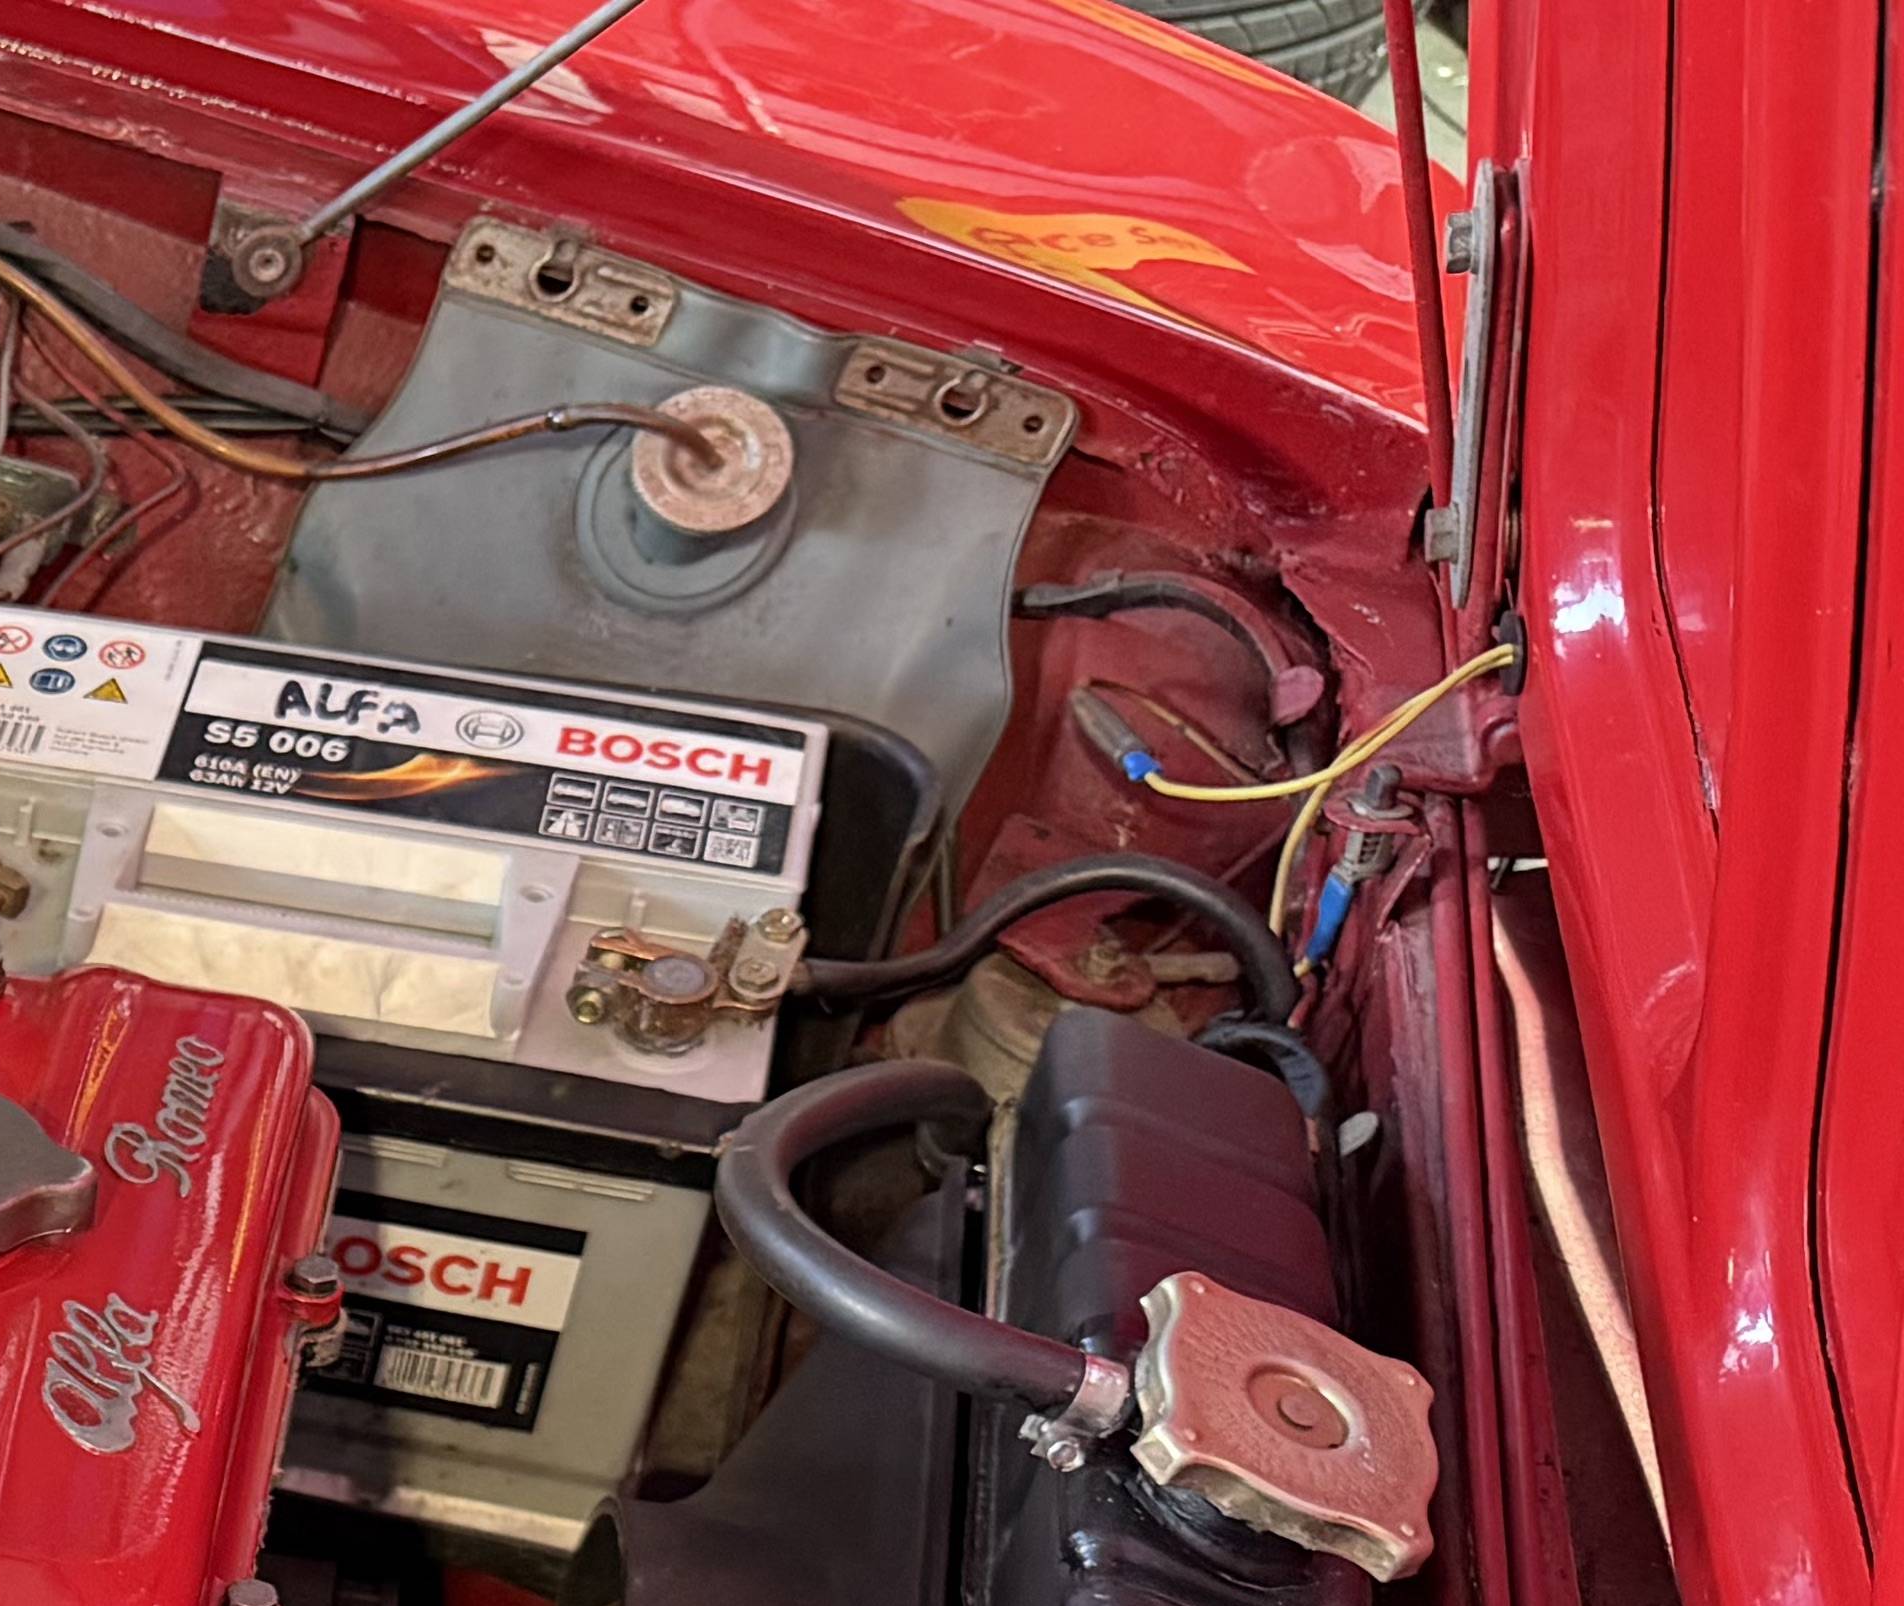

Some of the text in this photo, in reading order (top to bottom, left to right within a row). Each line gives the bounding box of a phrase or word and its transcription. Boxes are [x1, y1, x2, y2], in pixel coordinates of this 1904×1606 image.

[274, 680, 421, 734] ALFA
[194, 753, 302, 784] 610A (EN)
[203, 720, 352, 763] S5 006
[555, 725, 772, 787] BOSCH
[249, 778, 293, 796] 12V
[103, 1034, 227, 1199] Romeo
[332, 1235, 534, 1308] OSCH
